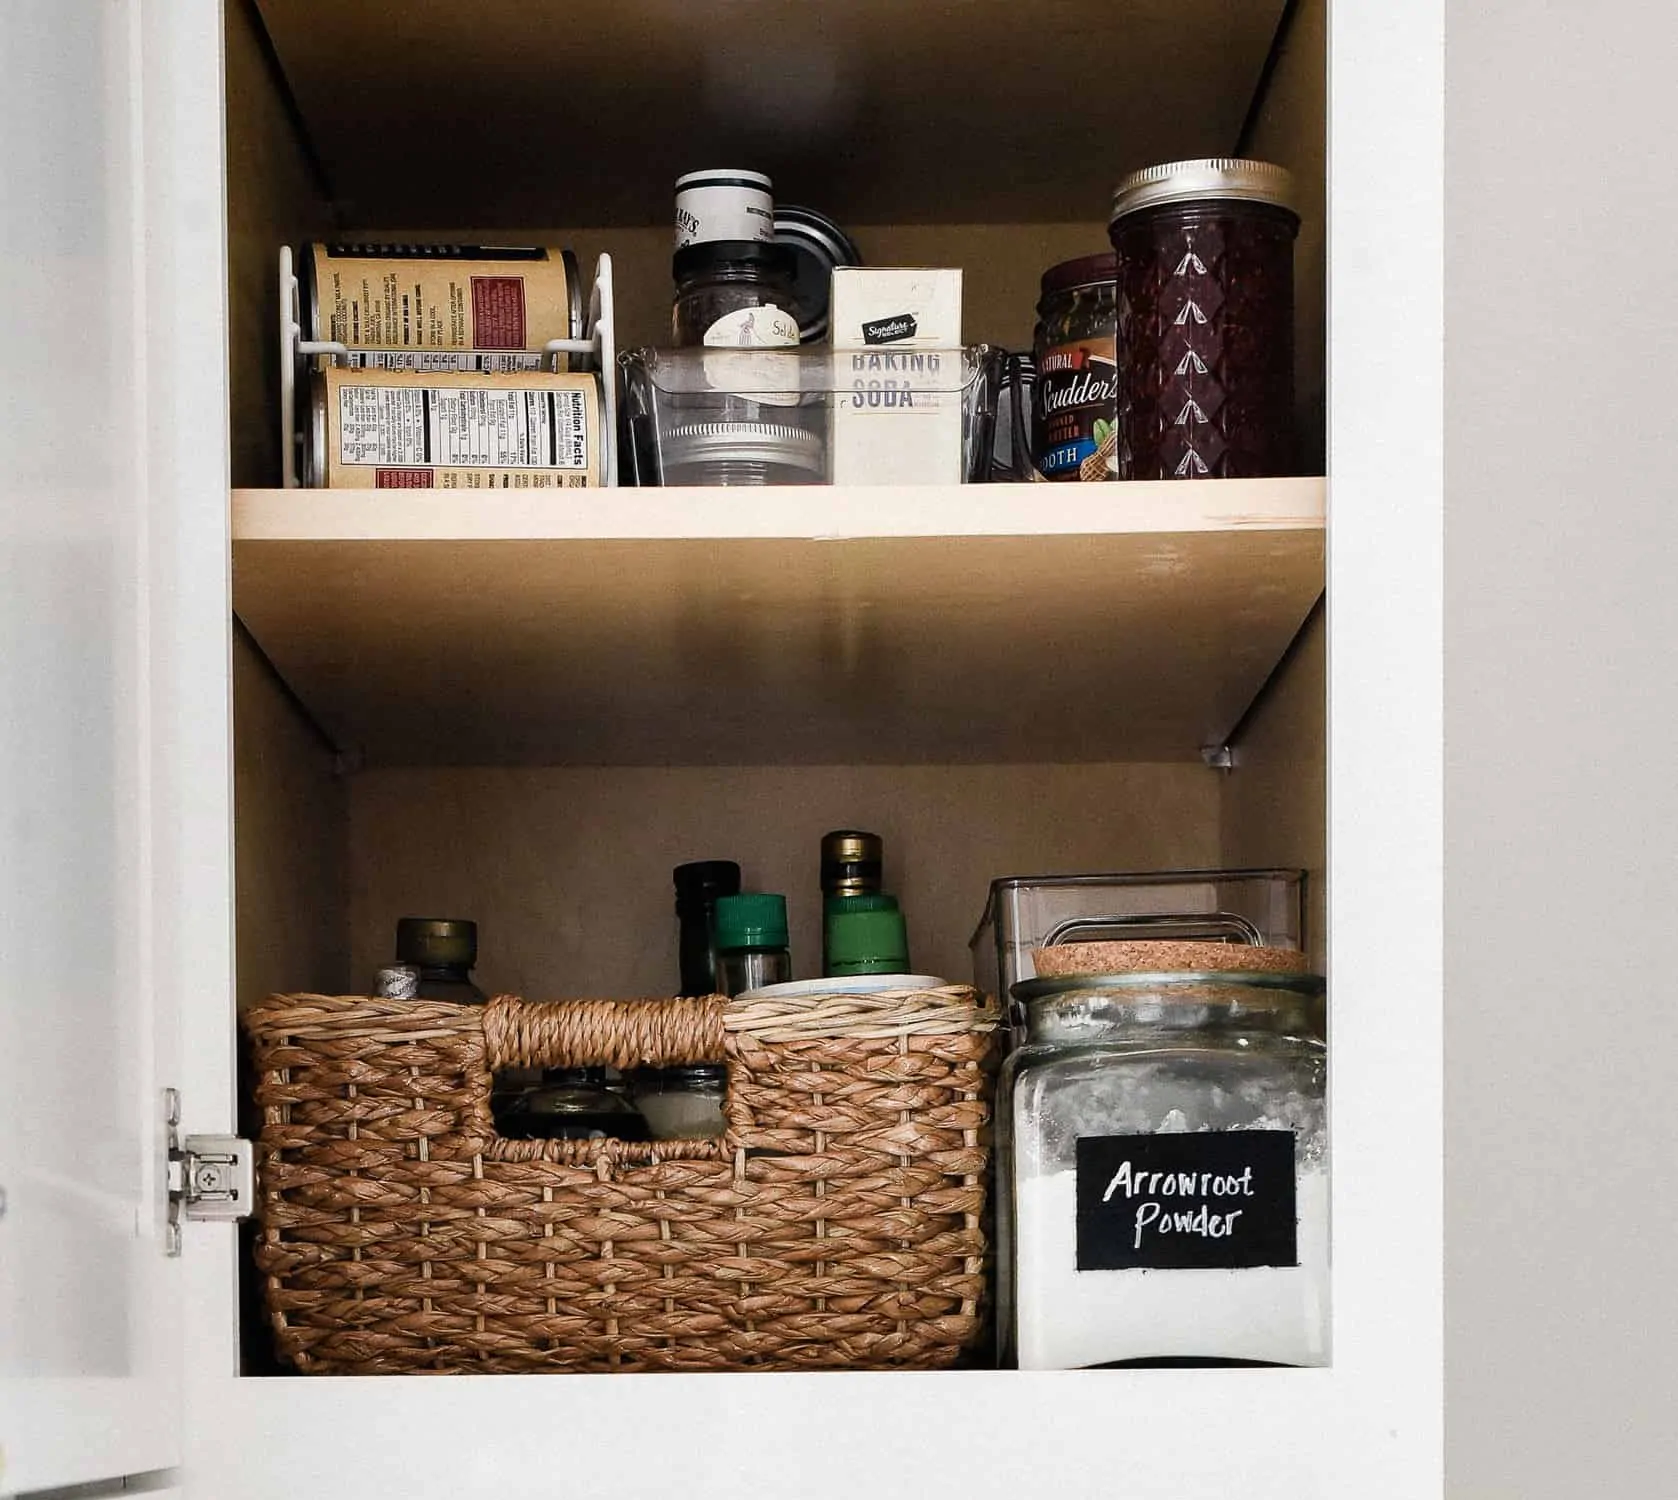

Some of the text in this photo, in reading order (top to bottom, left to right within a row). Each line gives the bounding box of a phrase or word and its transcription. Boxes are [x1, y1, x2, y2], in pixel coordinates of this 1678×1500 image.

[868, 320, 909, 338] Signature
[852, 353, 940, 372] BAKING
[1041, 353, 1073, 375] ATURAL
[852, 379, 914, 408] SODA
[1041, 372, 1117, 420] Scudder's
[571, 392, 584, 432] Nutrition
[573, 434, 585, 466] Facts
[1042, 447, 1077, 469] OOTH
[1102, 1160, 1255, 1202] Arrowroot
[1133, 1202, 1243, 1249] Powder
